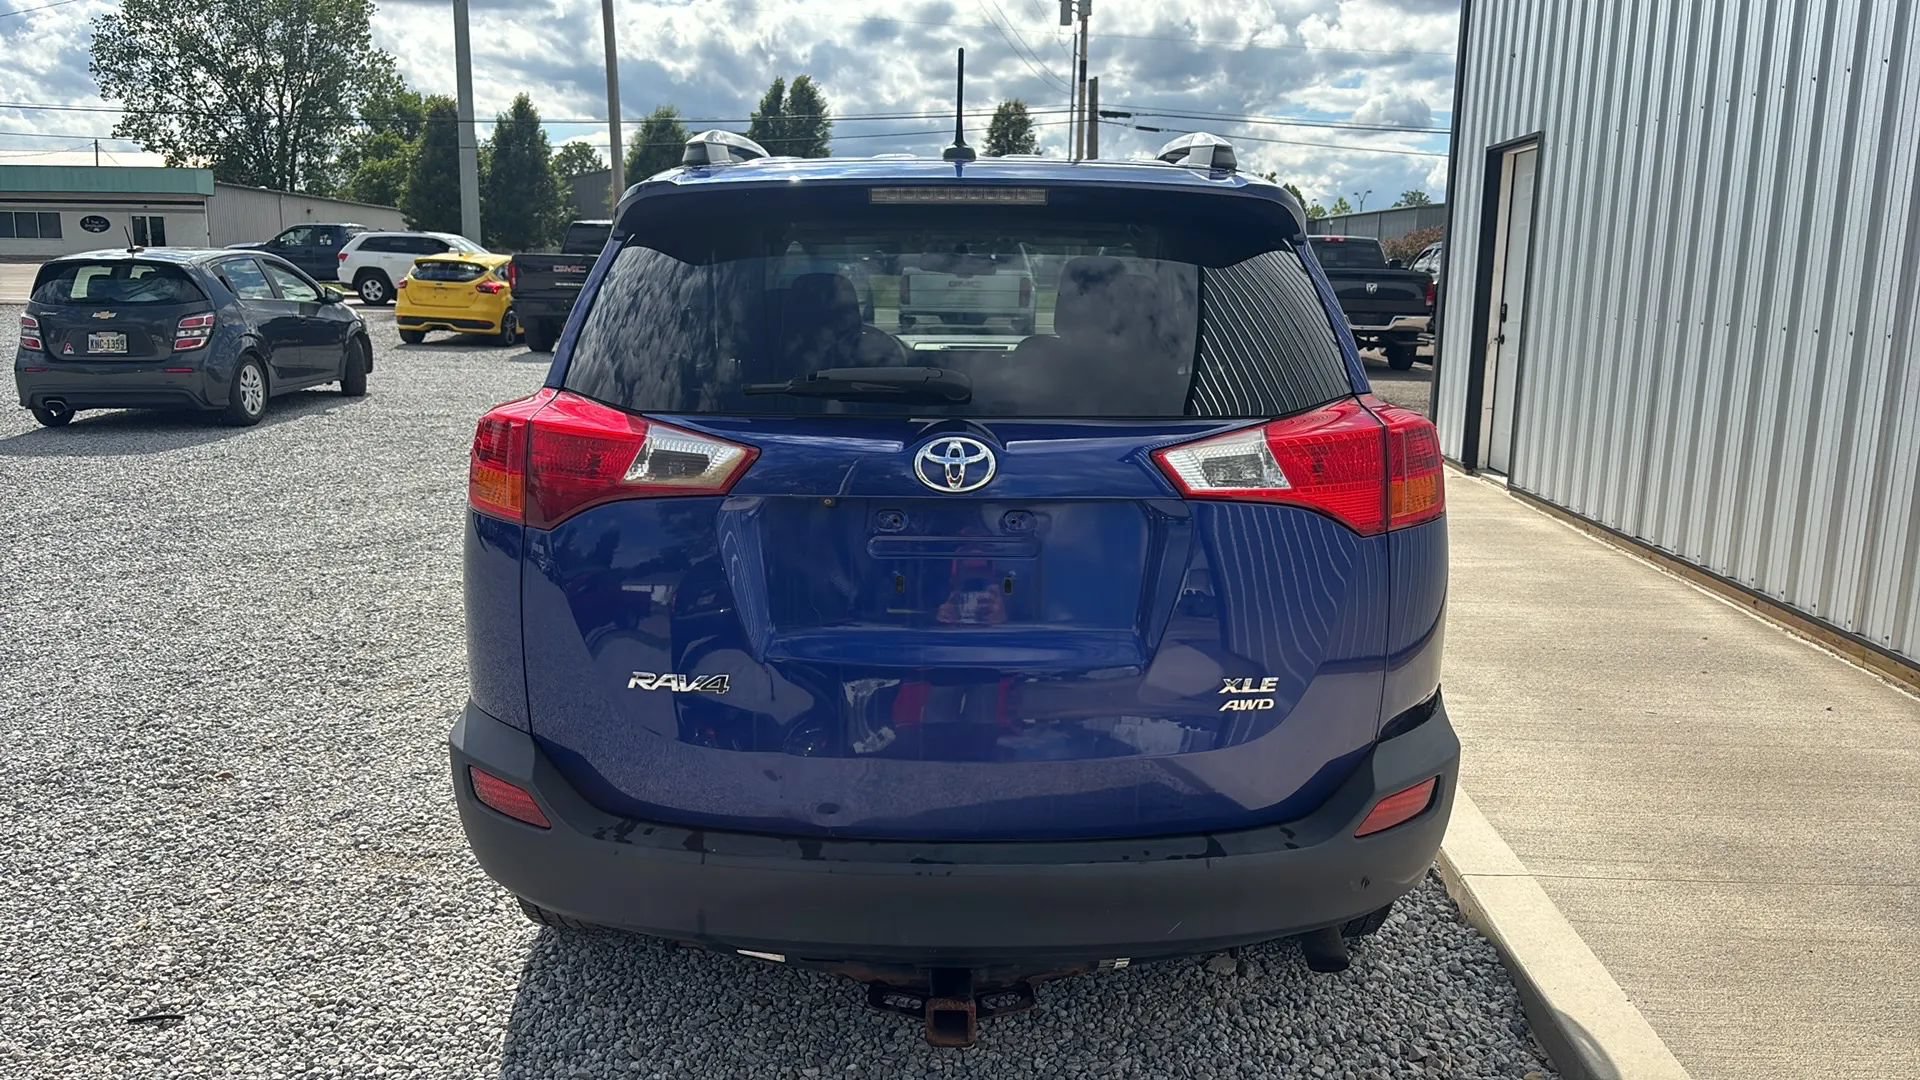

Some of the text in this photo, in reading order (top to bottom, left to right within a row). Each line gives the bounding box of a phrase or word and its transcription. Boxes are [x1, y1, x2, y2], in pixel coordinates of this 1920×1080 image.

[553, 265, 586, 273] GMC
[627, 671, 730, 694] RAV4
[1218, 677, 1279, 694] XLE
[1219, 698, 1274, 711] AWD
